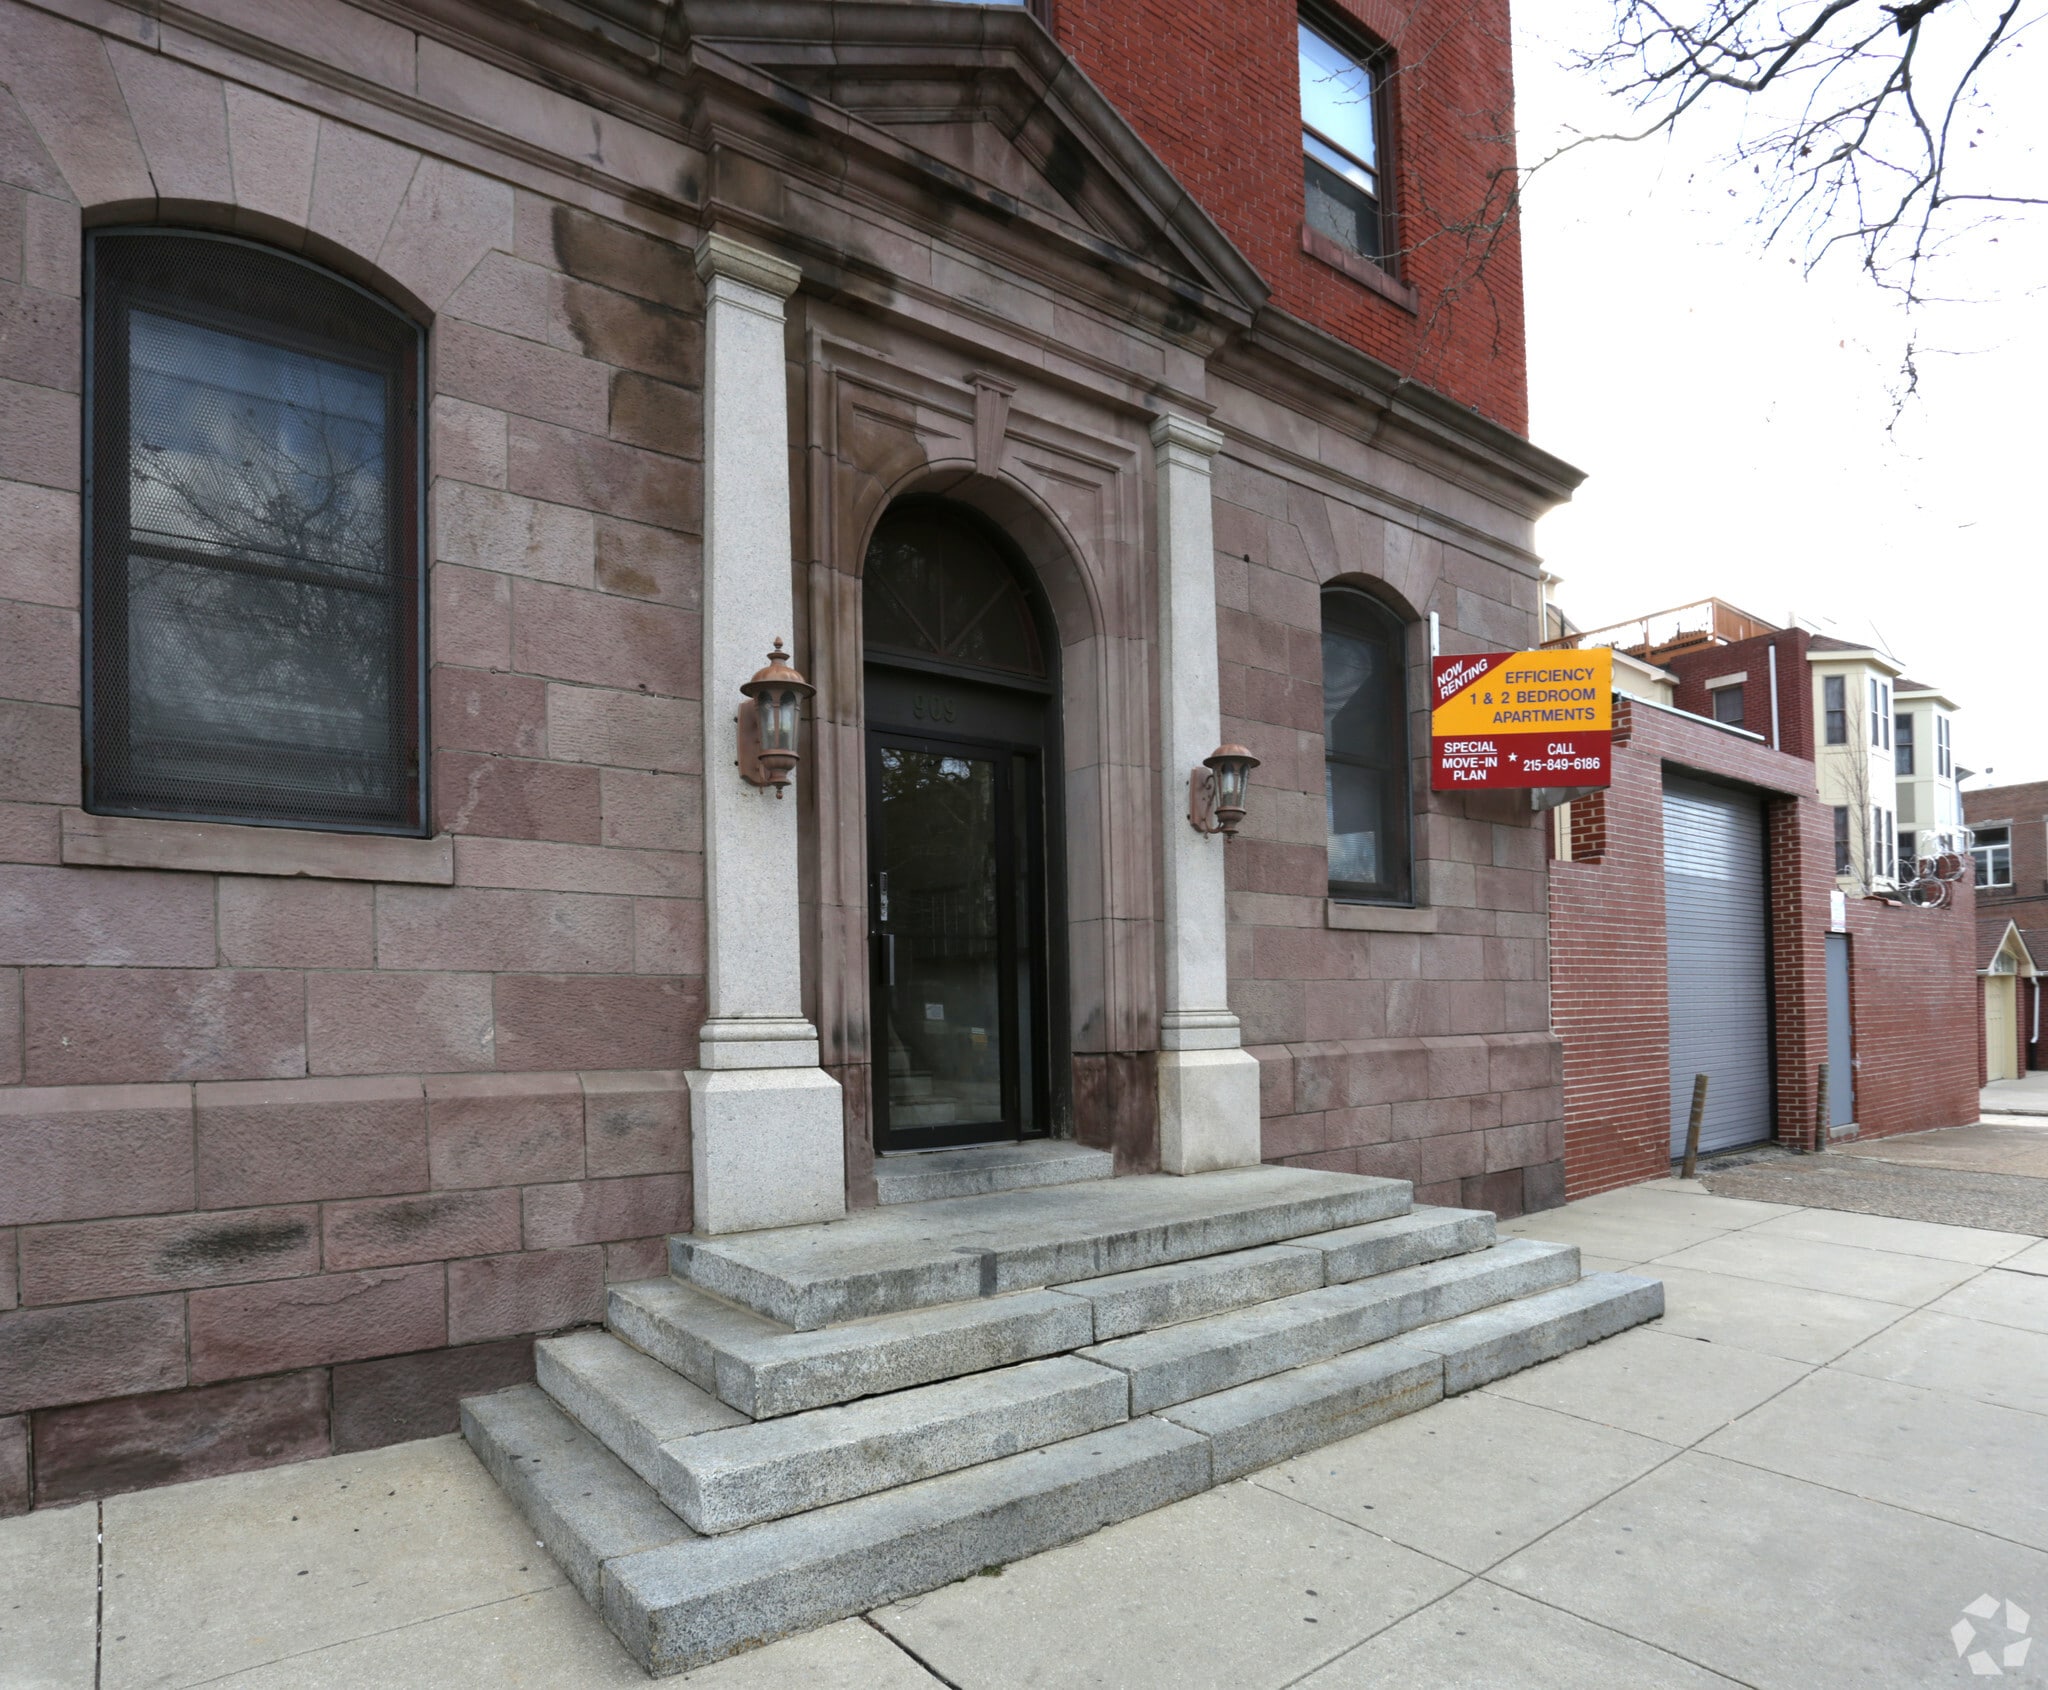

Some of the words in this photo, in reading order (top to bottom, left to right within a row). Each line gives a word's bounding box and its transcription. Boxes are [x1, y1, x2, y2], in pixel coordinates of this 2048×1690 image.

[1437, 660, 1463, 688] NOW
[1440, 658, 1488, 700] RENTING
[1505, 668, 1594, 684] EFFICIENCY
[1470, 693, 1477, 704] 1
[1483, 692, 1493, 704] &
[1501, 691, 1510, 704] 2
[1517, 688, 1596, 704] BEDROOM
[1493, 707, 1595, 723] APARTMENTS
[1444, 741, 1497, 754] SPECIAL
[1547, 743, 1575, 755] CALL
[1442, 757, 1497, 769] MOVE-IN
[1523, 757, 1600, 771] 215-849-6186
[1453, 770, 1487, 781] PLAN
